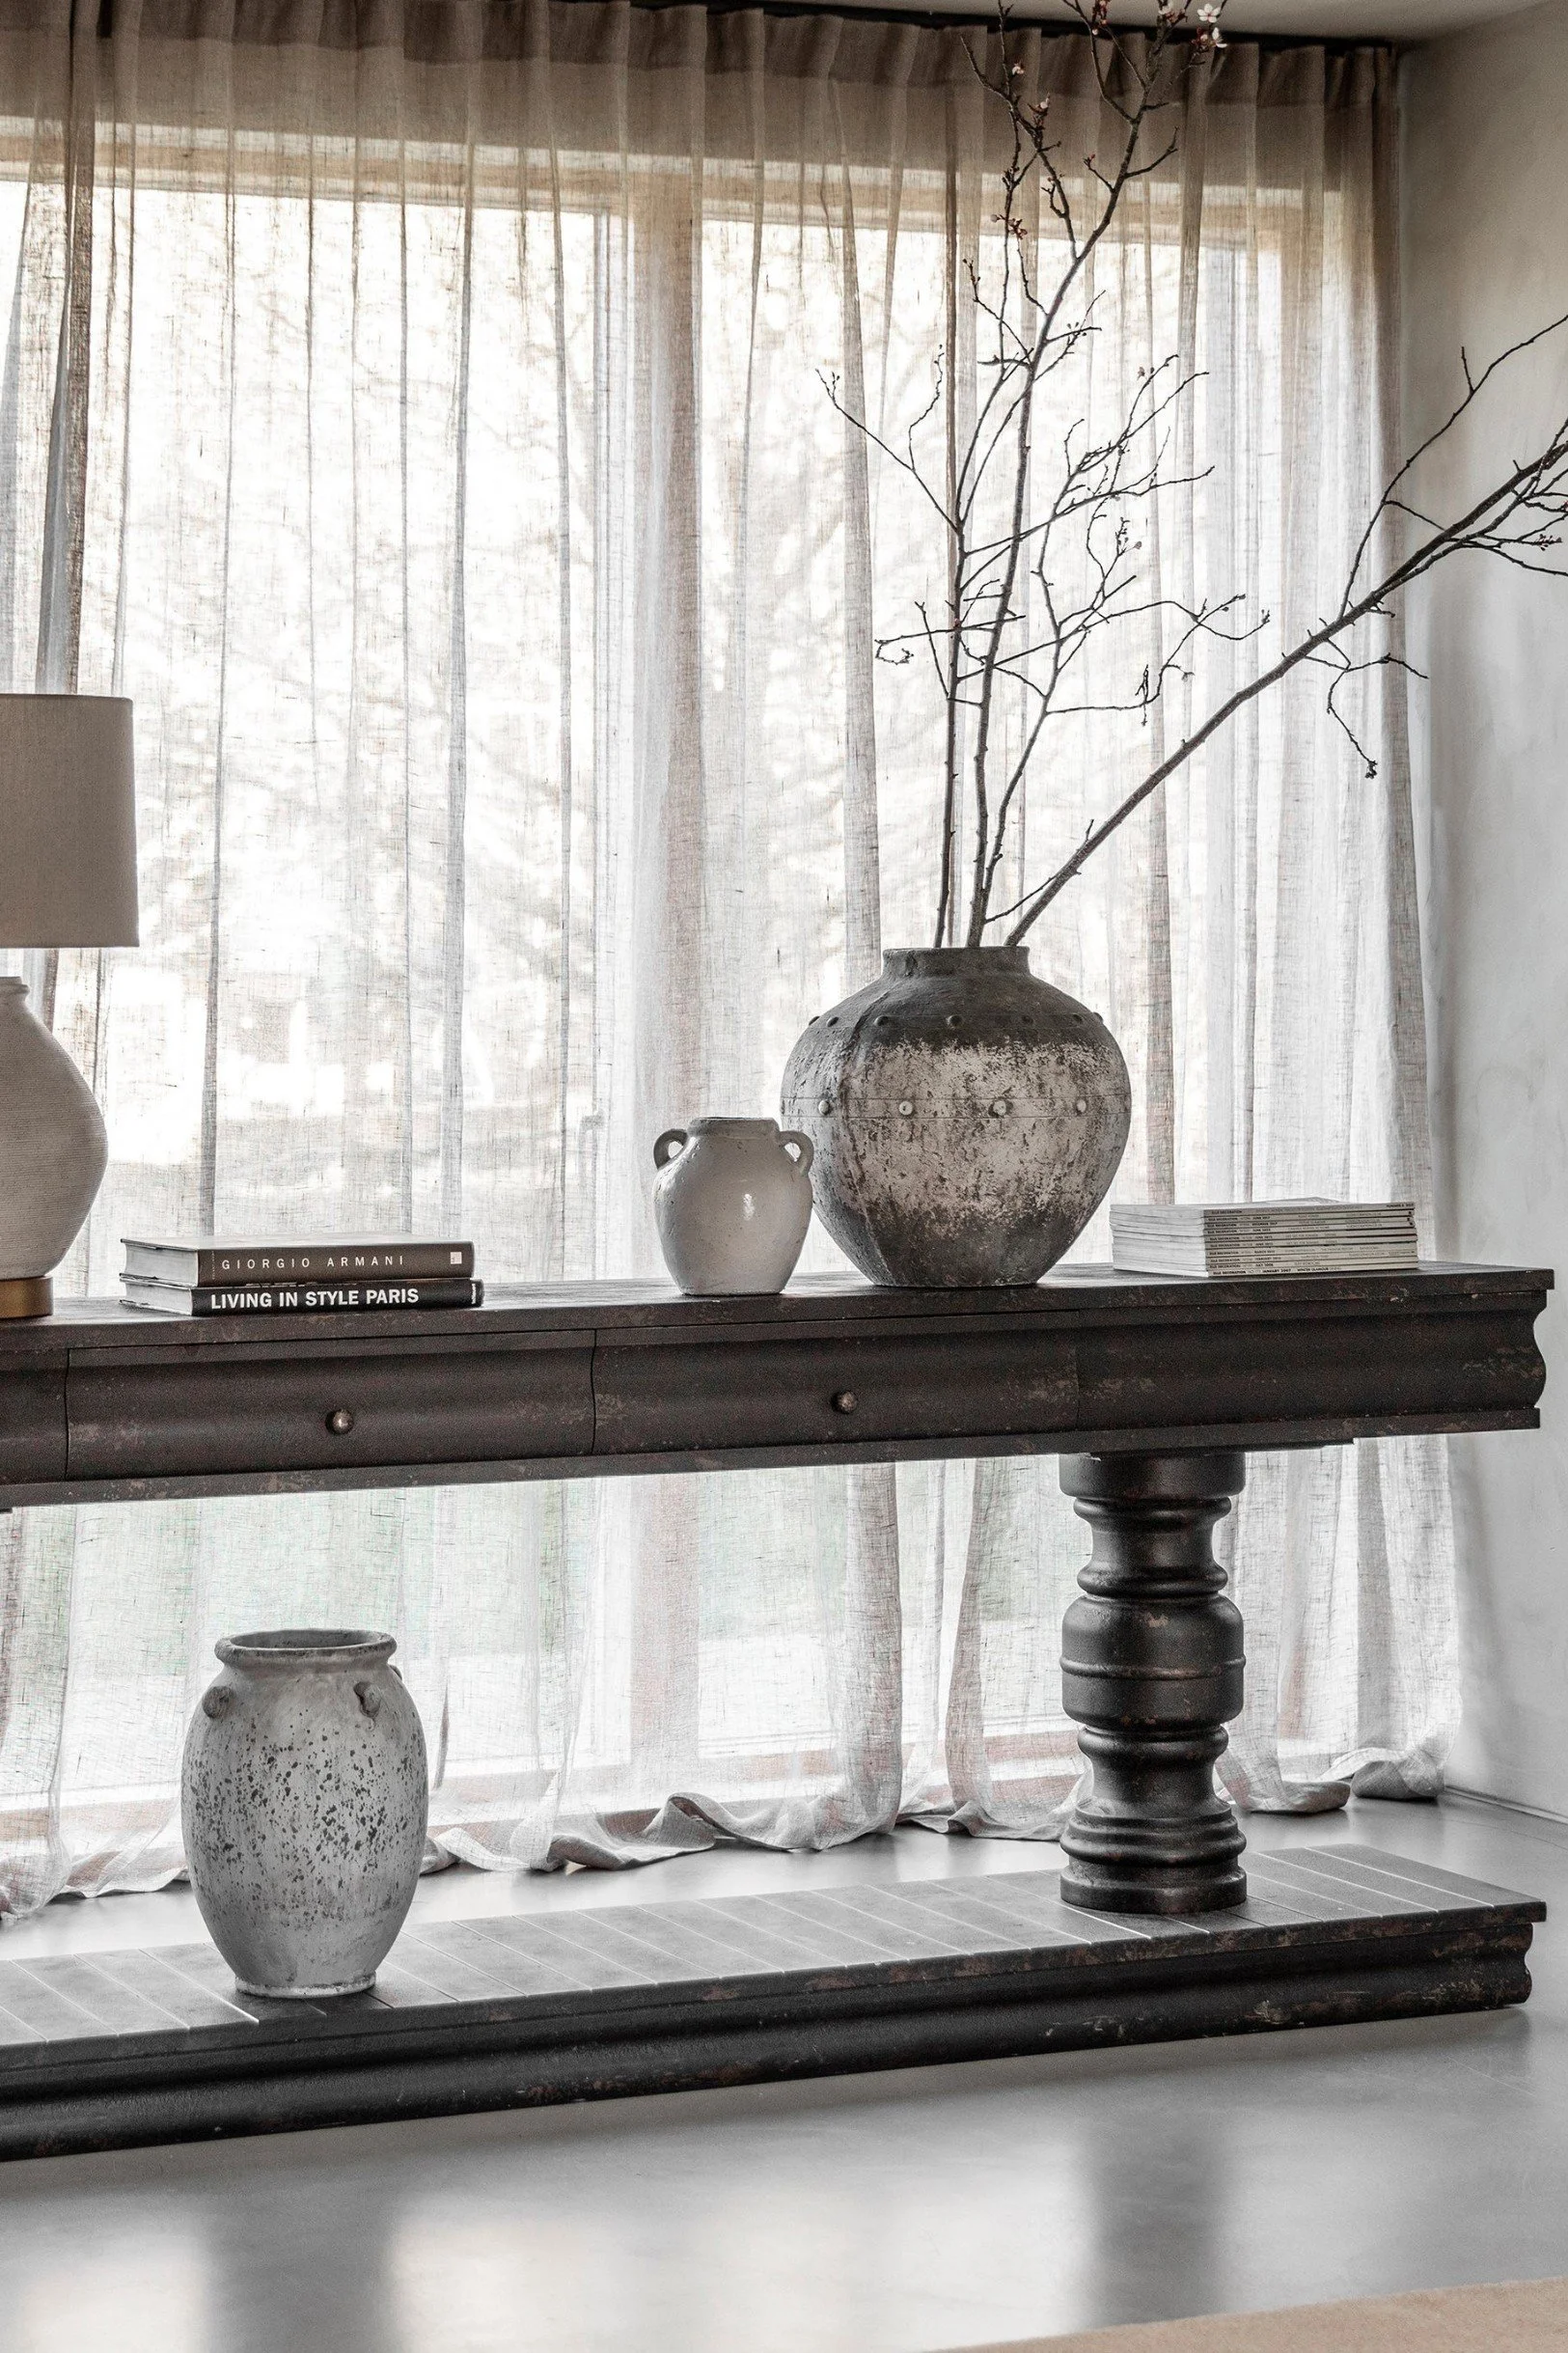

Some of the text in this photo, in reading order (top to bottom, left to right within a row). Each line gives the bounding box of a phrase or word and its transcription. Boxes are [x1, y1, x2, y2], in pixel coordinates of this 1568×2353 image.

[222, 1258, 310, 1270] GIORGIO
[327, 1256, 404, 1267] ARMANI
[211, 1288, 420, 1309] LIVING IN STYLE PARIS
